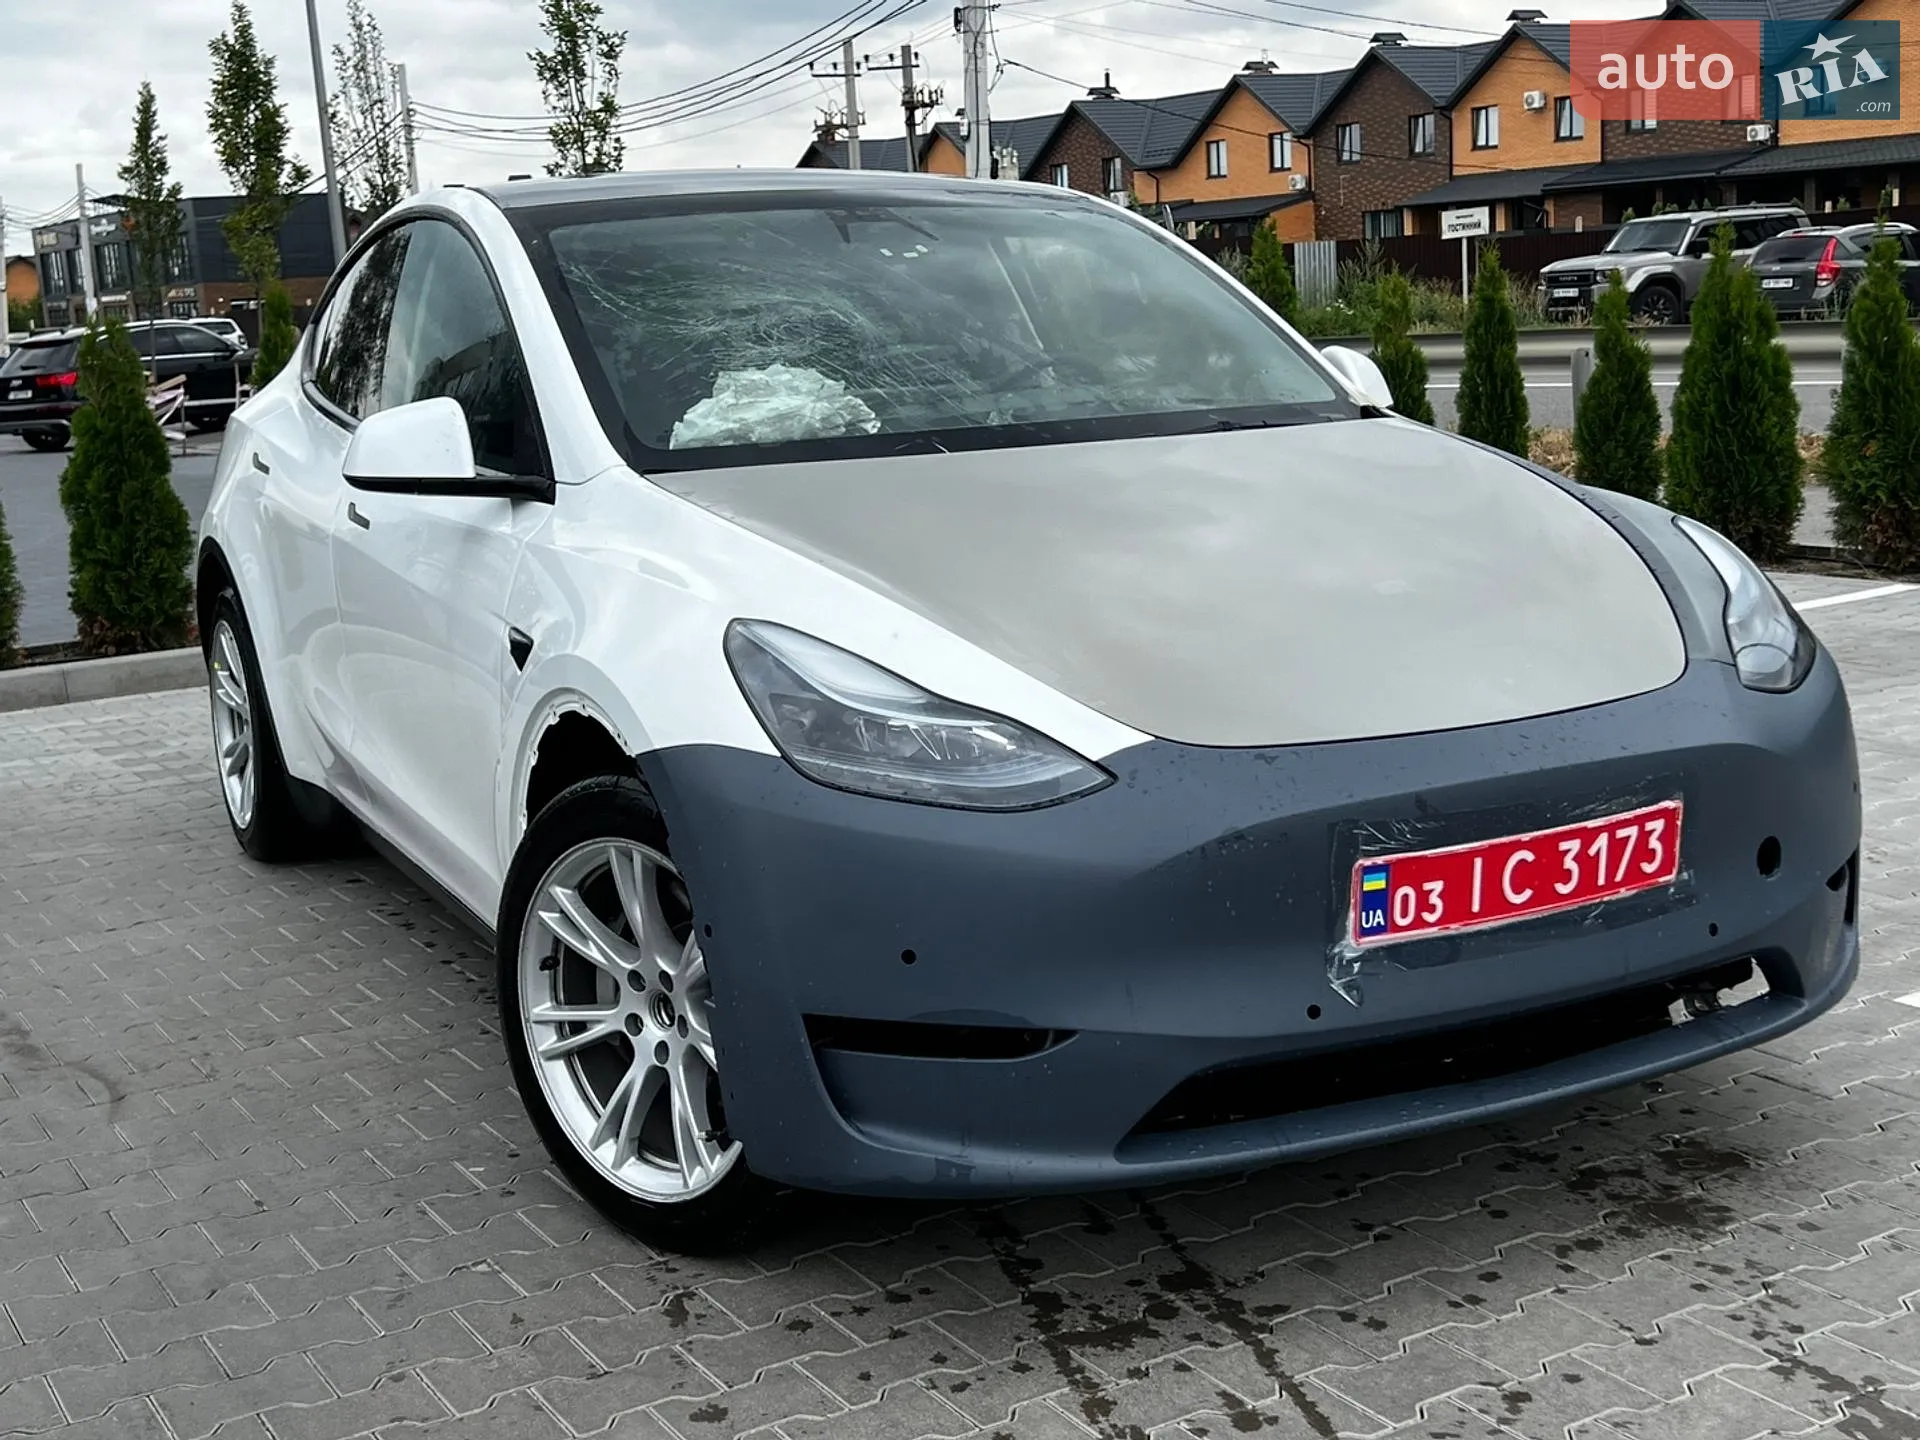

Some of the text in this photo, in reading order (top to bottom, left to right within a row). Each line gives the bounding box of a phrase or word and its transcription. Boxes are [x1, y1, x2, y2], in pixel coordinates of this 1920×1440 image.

[1393, 880, 1444, 926] 03
[1553, 818, 1665, 895] 3173
[1361, 908, 1385, 928] UA
